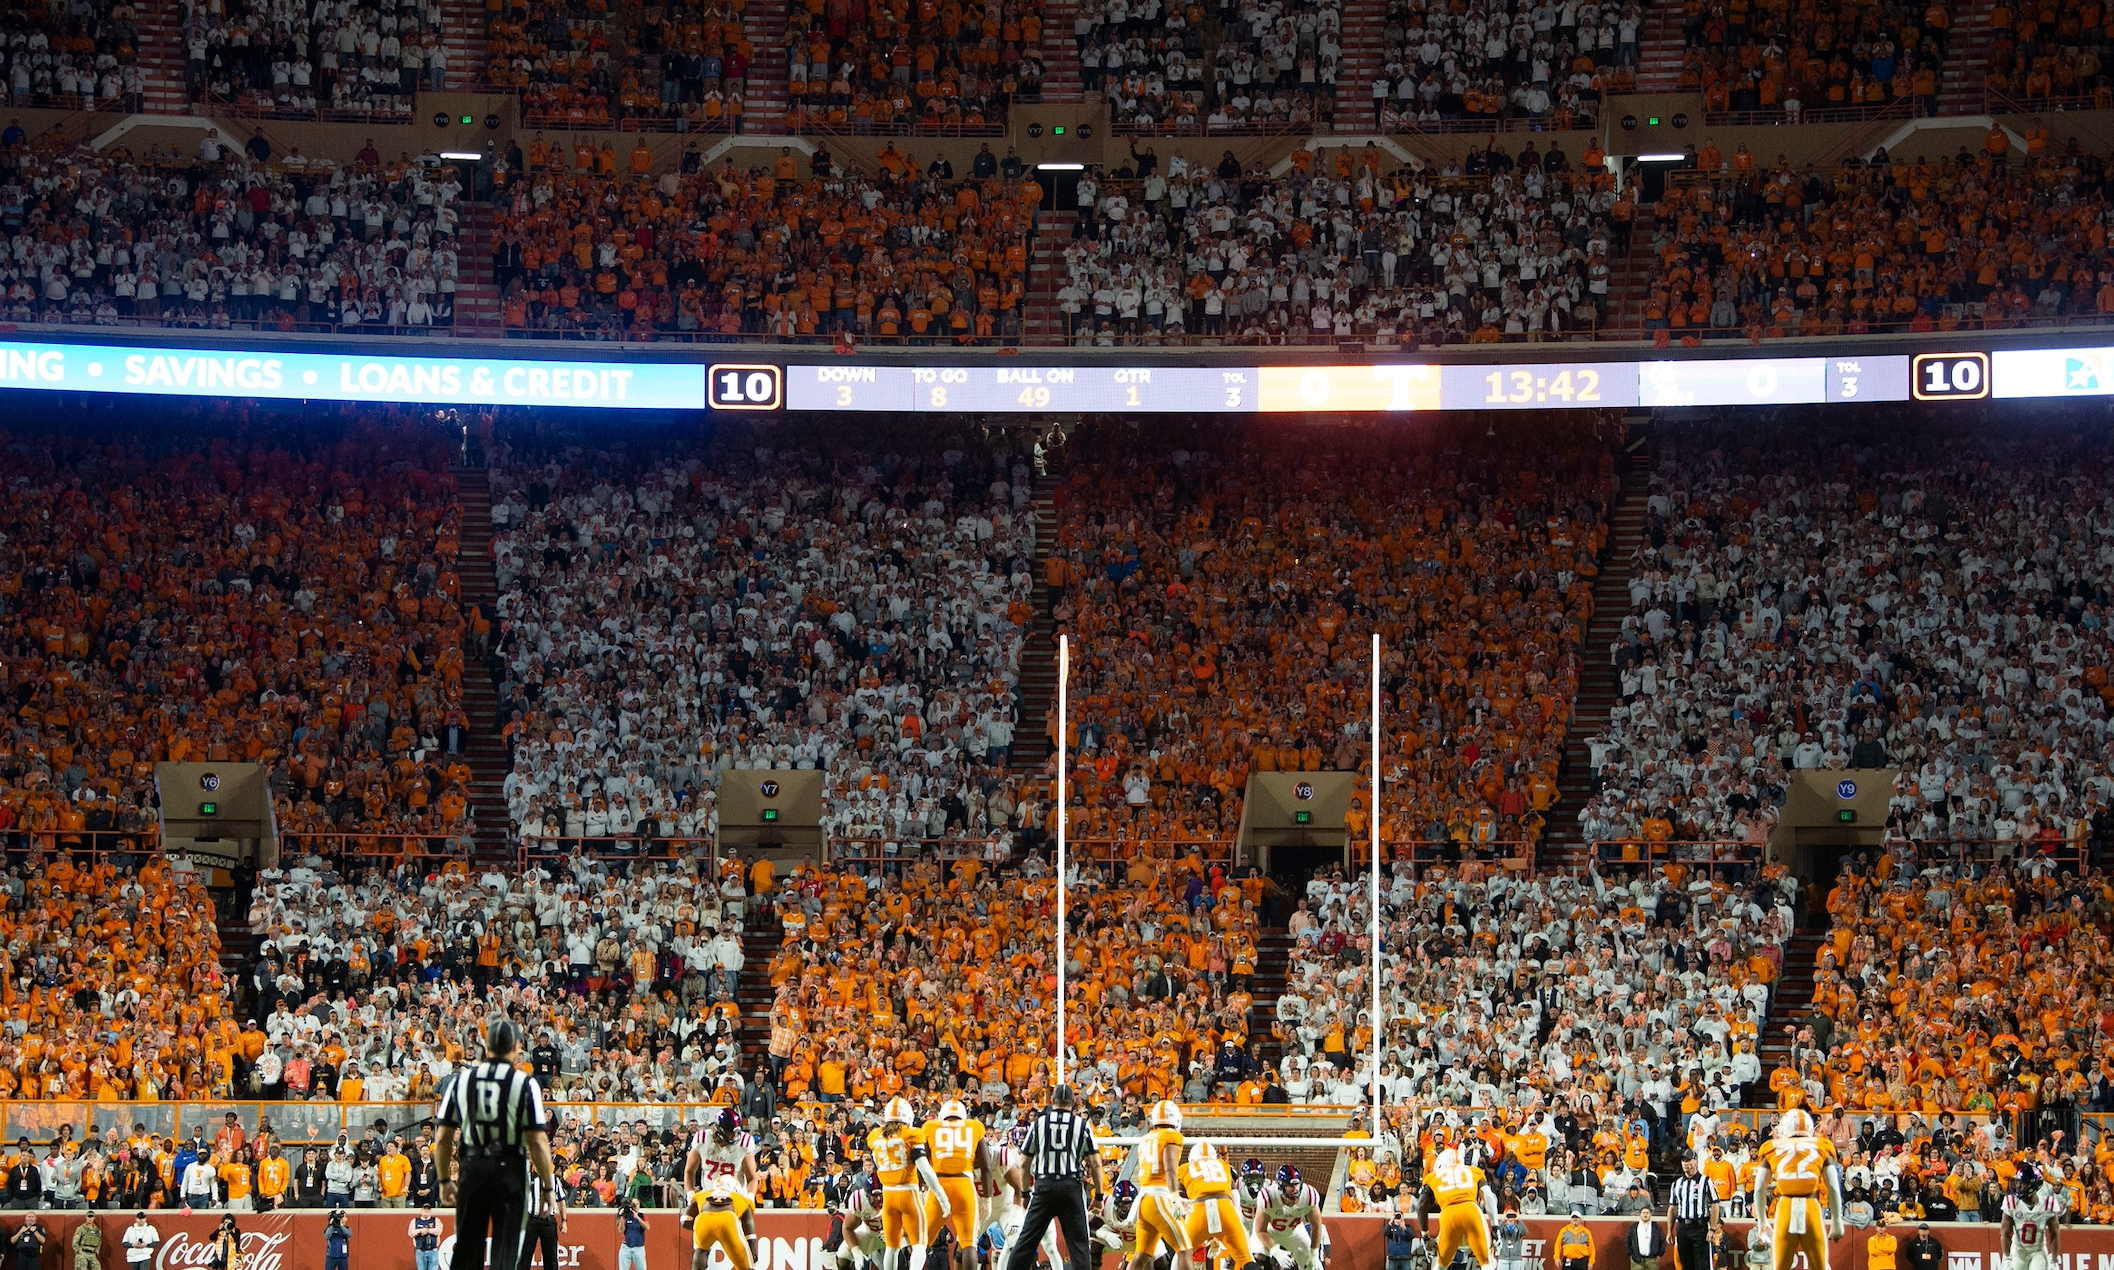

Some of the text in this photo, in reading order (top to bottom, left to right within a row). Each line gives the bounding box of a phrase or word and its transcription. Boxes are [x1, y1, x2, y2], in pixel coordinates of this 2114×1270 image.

[435, 116, 449, 124] YY6
[485, 118, 500, 126] YY7
[1673, 117, 1688, 125] YY9
[0, 349, 65, 382] ING
[124, 354, 283, 390] SAVINGS
[817, 367, 876, 383] DOWN
[911, 368, 968, 384] TO GO
[996, 368, 1074, 384] BALL ON
[1836, 361, 1862, 373] TOL
[1925, 360, 1980, 391] 10
[341, 362, 633, 401] LOANS & CREDIT
[720, 372, 773, 402] 10
[1114, 369, 1151, 384] QTR
[1222, 372, 1248, 384] TOL
[1484, 369, 1602, 403] 13:42
[1746, 363, 1778, 398] 0
[1841, 376, 1859, 398] 3
[836, 385, 853, 406] 3
[930, 386, 948, 408] 8
[1017, 386, 1051, 407] 49
[1125, 385, 1142, 406] 1
[1225, 387, 1242, 408] 3
[1300, 370, 1331, 406] 0
[202, 776, 217, 787] Y6
[763, 784, 778, 795] Y7
[1296, 786, 1312, 797] Y8
[1839, 783, 1856, 794] Y9
[765, 811, 776, 819] EXIT
[476, 1080, 501, 1122] B
[935, 1127, 973, 1159] 94
[1050, 1123, 1069, 1151] U
[873, 1137, 908, 1173] 33
[1775, 1142, 1819, 1180] 22
[705, 1159, 736, 1181] 78
[1188, 1159, 1227, 1183] 48
[1435, 1168, 1475, 1193] 30
[1272, 1217, 1301, 1232] 64
[2021, 1223, 2038, 1245] 0
